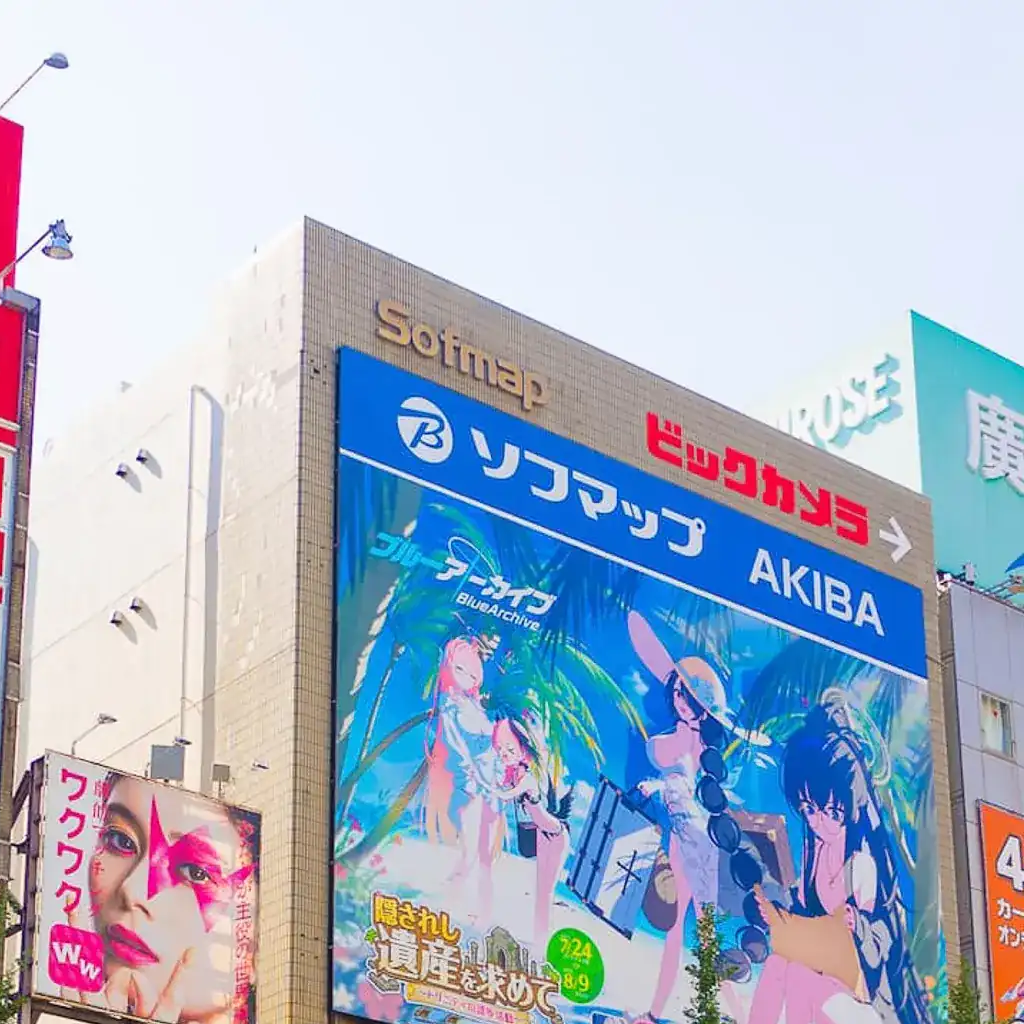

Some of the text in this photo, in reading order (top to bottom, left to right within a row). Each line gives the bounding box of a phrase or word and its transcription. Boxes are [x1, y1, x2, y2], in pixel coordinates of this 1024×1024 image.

[376, 299, 551, 411] Sofmap
[471, 426, 707, 558] ソフマップ
[748, 547, 886, 638] AKIBA
[645, 411, 869, 546] ビックカメラ
[55, 768, 88, 913] ワクワク
[373, 893, 461, 942] 隠されし
[375, 927, 561, 1016] 遺産を求めて
